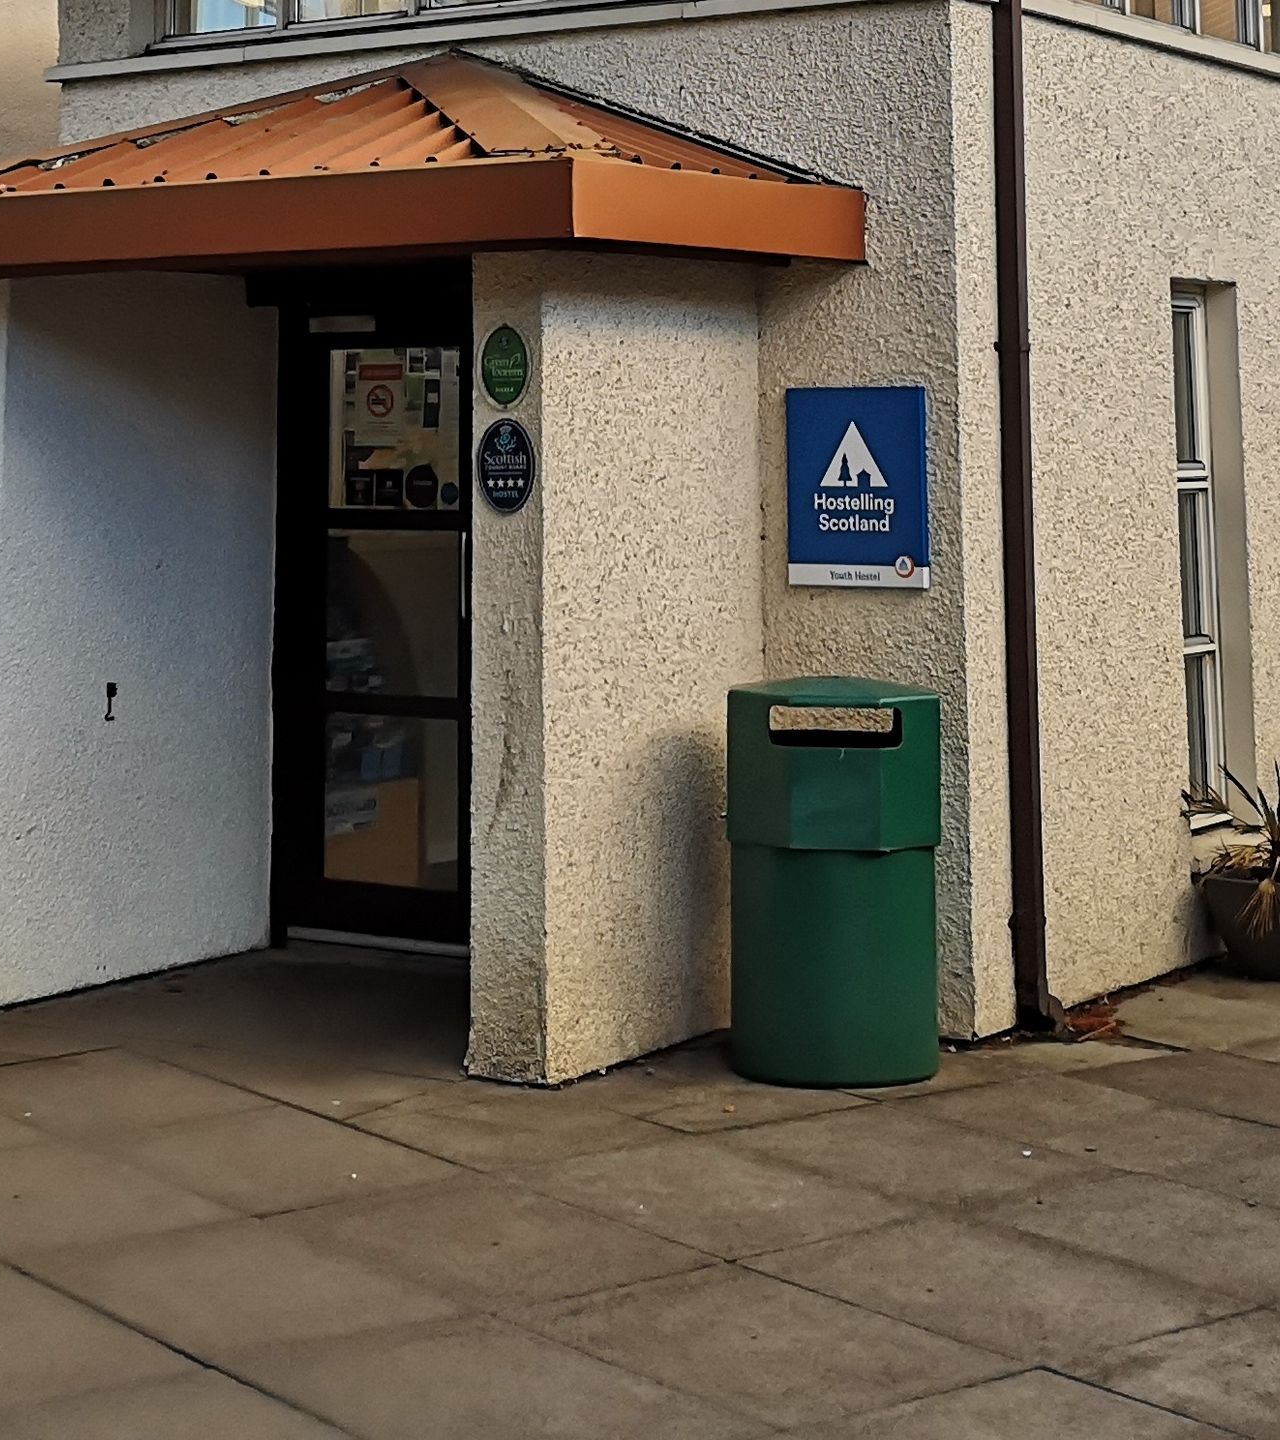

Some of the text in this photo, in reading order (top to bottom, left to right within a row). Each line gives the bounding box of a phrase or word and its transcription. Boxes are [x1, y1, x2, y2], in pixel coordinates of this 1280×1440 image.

[484, 451, 527, 465] Scottish
[813, 492, 895, 515] Hostelling
[818, 513, 890, 532] Scotland
[829, 570, 881, 581] Youth Hostel
